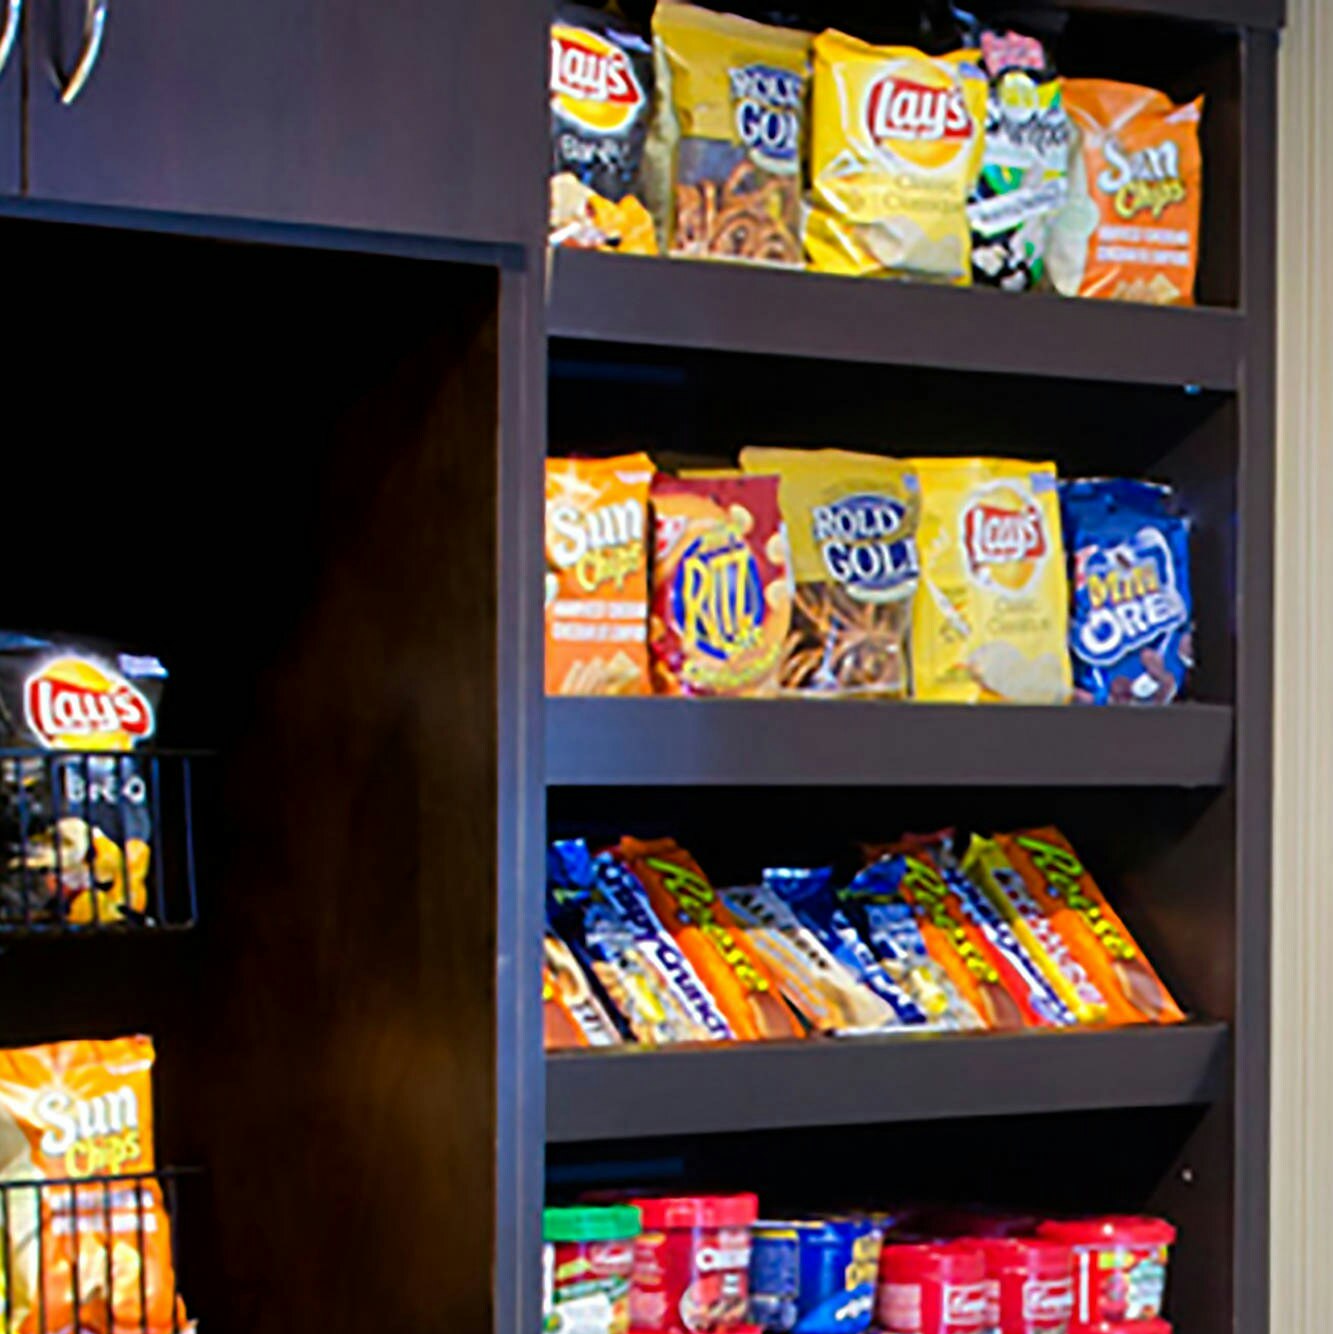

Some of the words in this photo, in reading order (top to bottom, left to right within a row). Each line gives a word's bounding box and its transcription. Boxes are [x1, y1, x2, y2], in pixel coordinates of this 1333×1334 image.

[873, 78, 968, 140] Lay's
[552, 498, 643, 569] Sun
[812, 502, 902, 541] ROLD
[37, 679, 143, 735] Lay's
[35, 1086, 139, 1157] Sun
